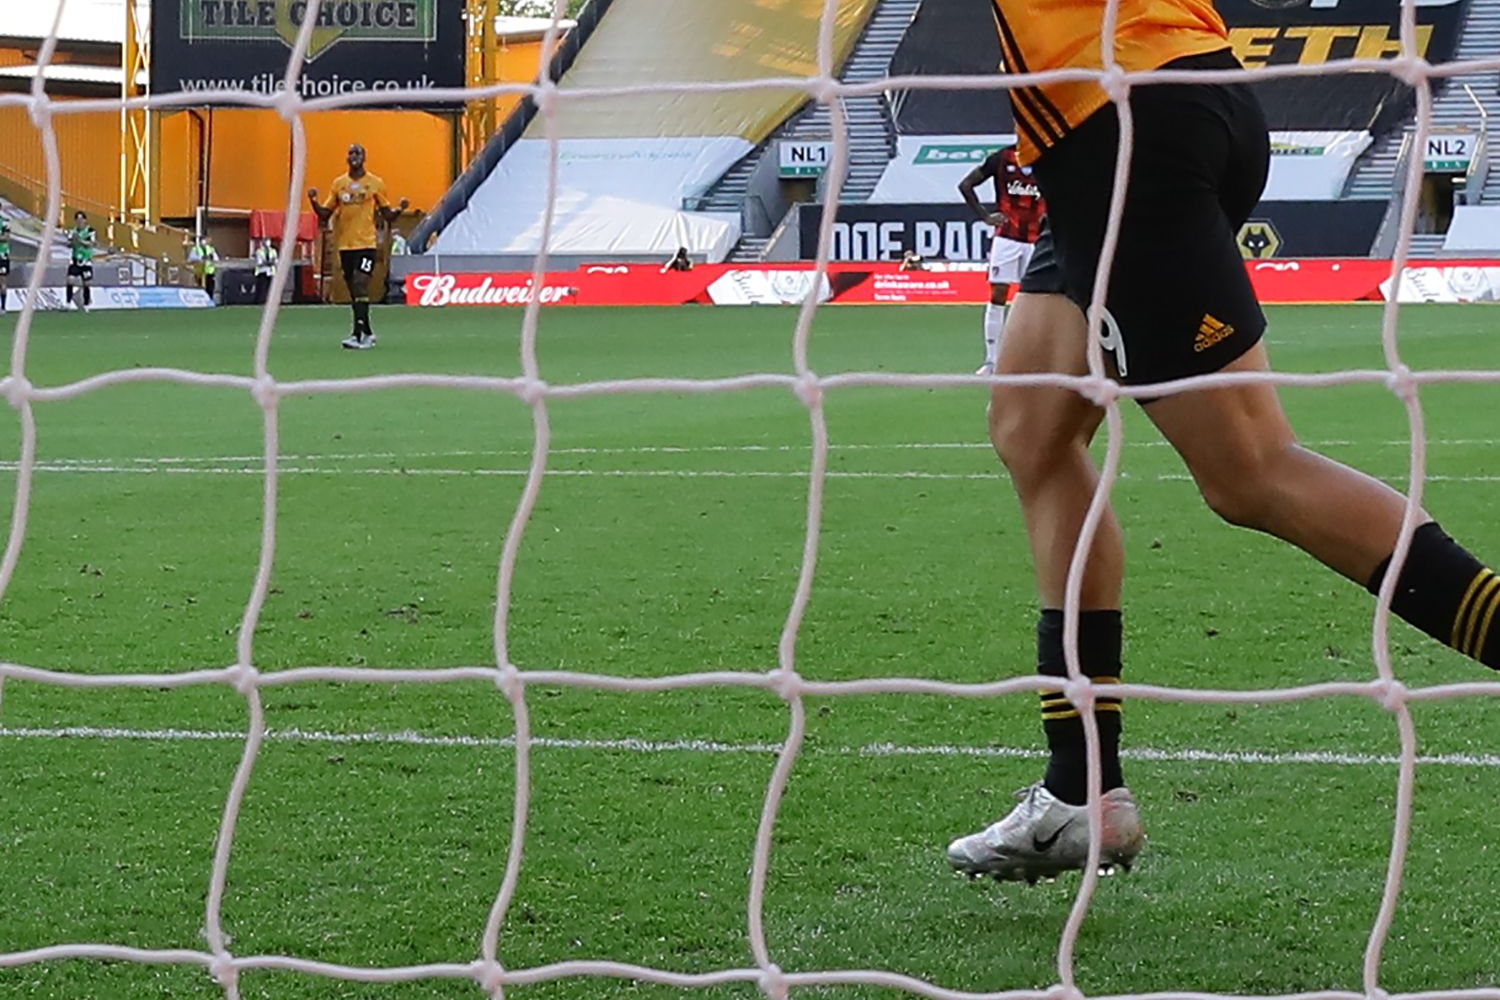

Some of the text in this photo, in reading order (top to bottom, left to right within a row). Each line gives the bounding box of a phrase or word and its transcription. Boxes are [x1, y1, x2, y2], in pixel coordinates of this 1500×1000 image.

[201, 0, 417, 28] TILE CHOICE
[179, 73, 436, 96] www.tilehoice.co.uk
[791, 146, 826, 162] NL1
[1427, 139, 1466, 156] NL2
[915, 221, 996, 260] PAC
[1087, 304, 1128, 378] 9
